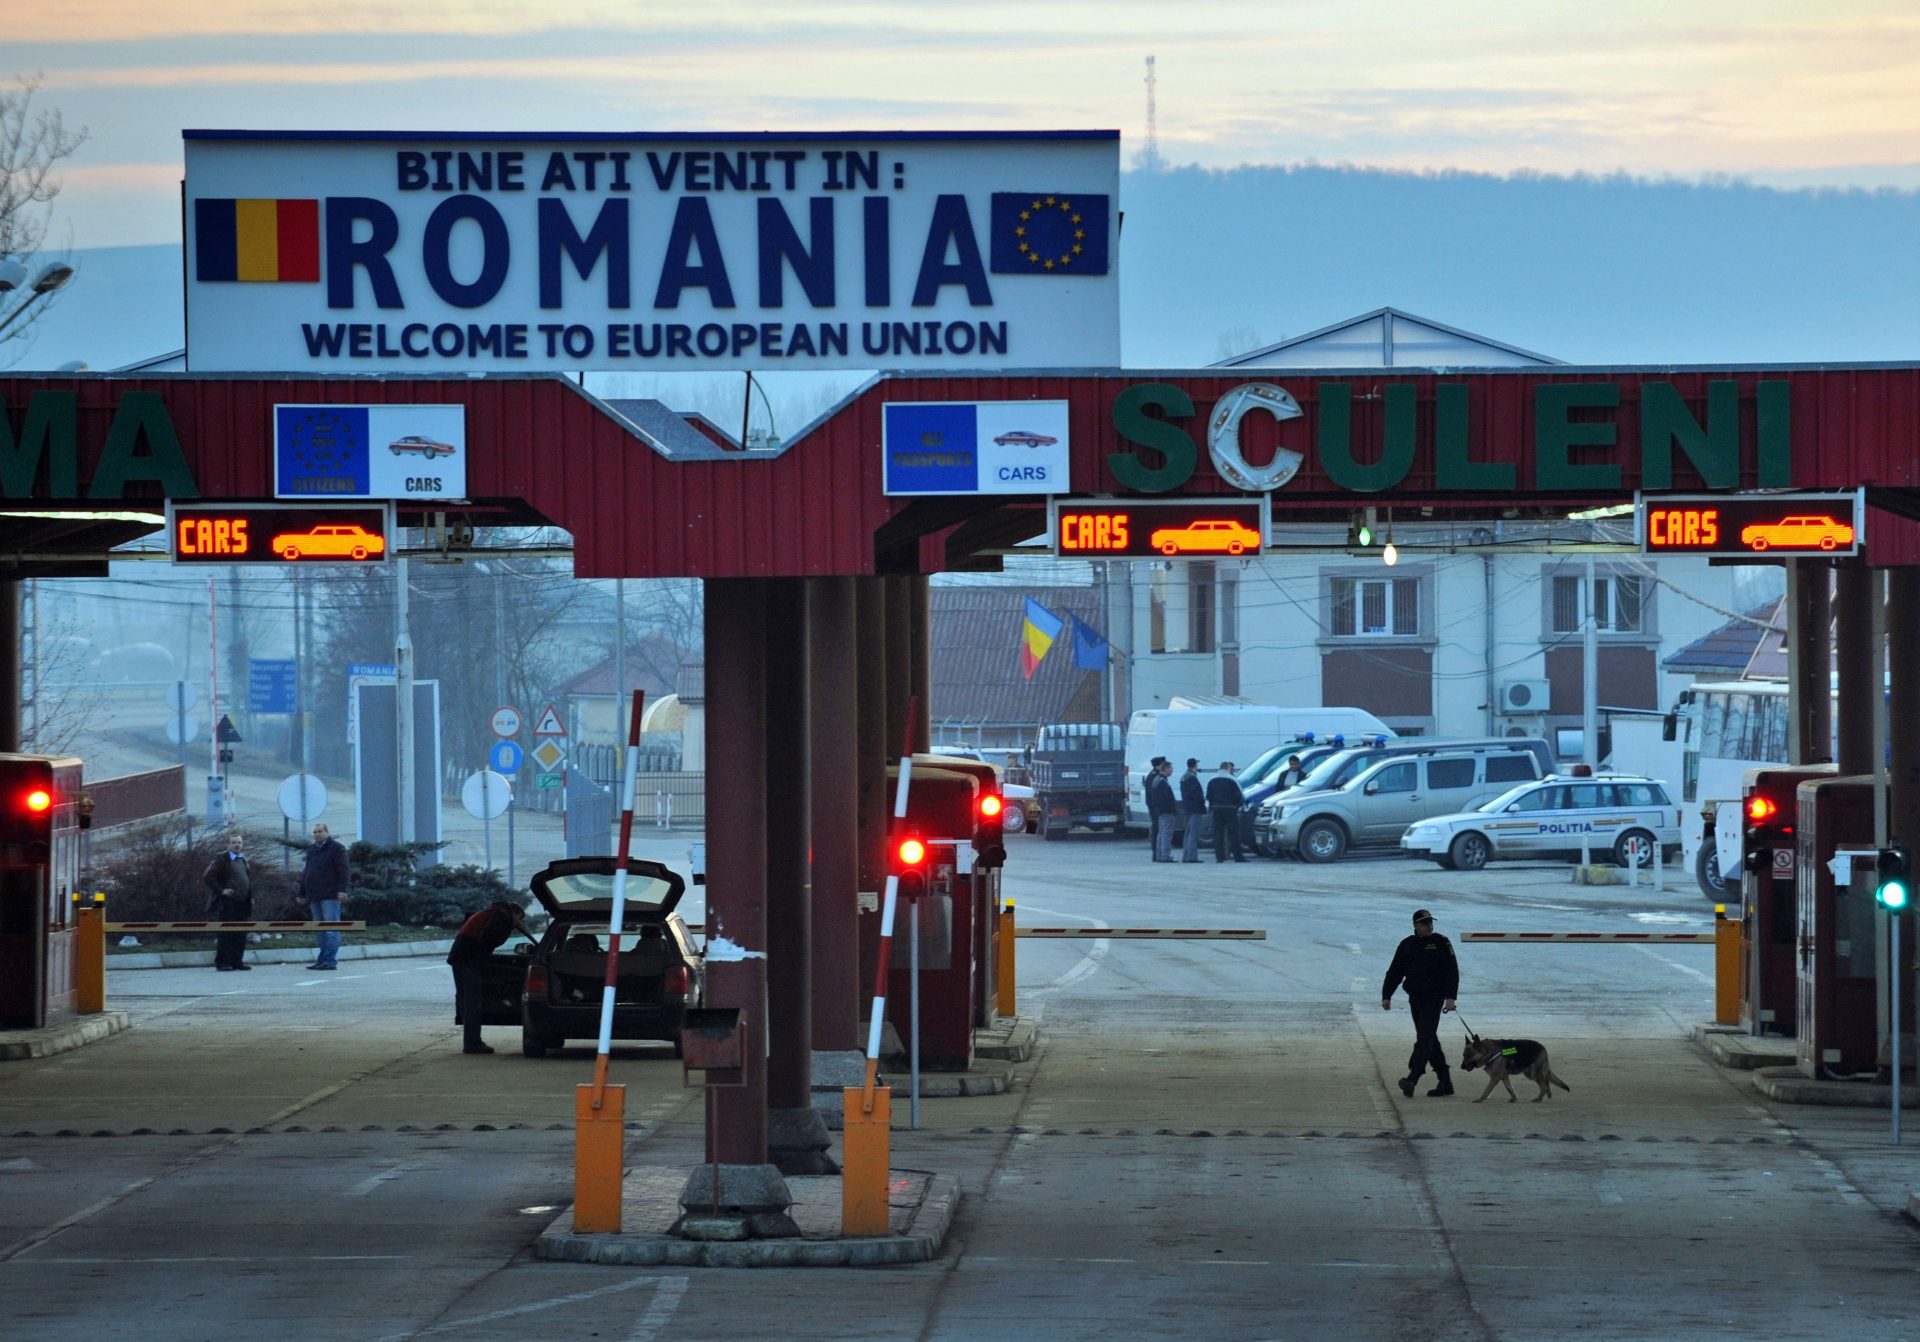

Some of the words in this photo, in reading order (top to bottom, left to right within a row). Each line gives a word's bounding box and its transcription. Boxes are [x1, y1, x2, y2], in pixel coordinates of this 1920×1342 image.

[397, 151, 524, 191] BINE
[541, 151, 631, 191] ATI
[646, 151, 806, 191] VENIT
[325, 193, 994, 309] ROMANIA
[302, 323, 528, 358] WELCOME
[538, 323, 595, 358] TO
[608, 322, 848, 358] EUROPEAN
[862, 321, 1008, 356] UNION
[1107, 379, 1791, 492] SCULENI
[292, 476, 356, 492] CITIZENS
[405, 477, 442, 492] CARS
[998, 467, 1046, 481] CARS
[179, 519, 248, 554] CARS
[1061, 514, 1128, 549] CARS
[1650, 511, 1718, 545] CARS
[1538, 823, 1593, 834] POLITIA
